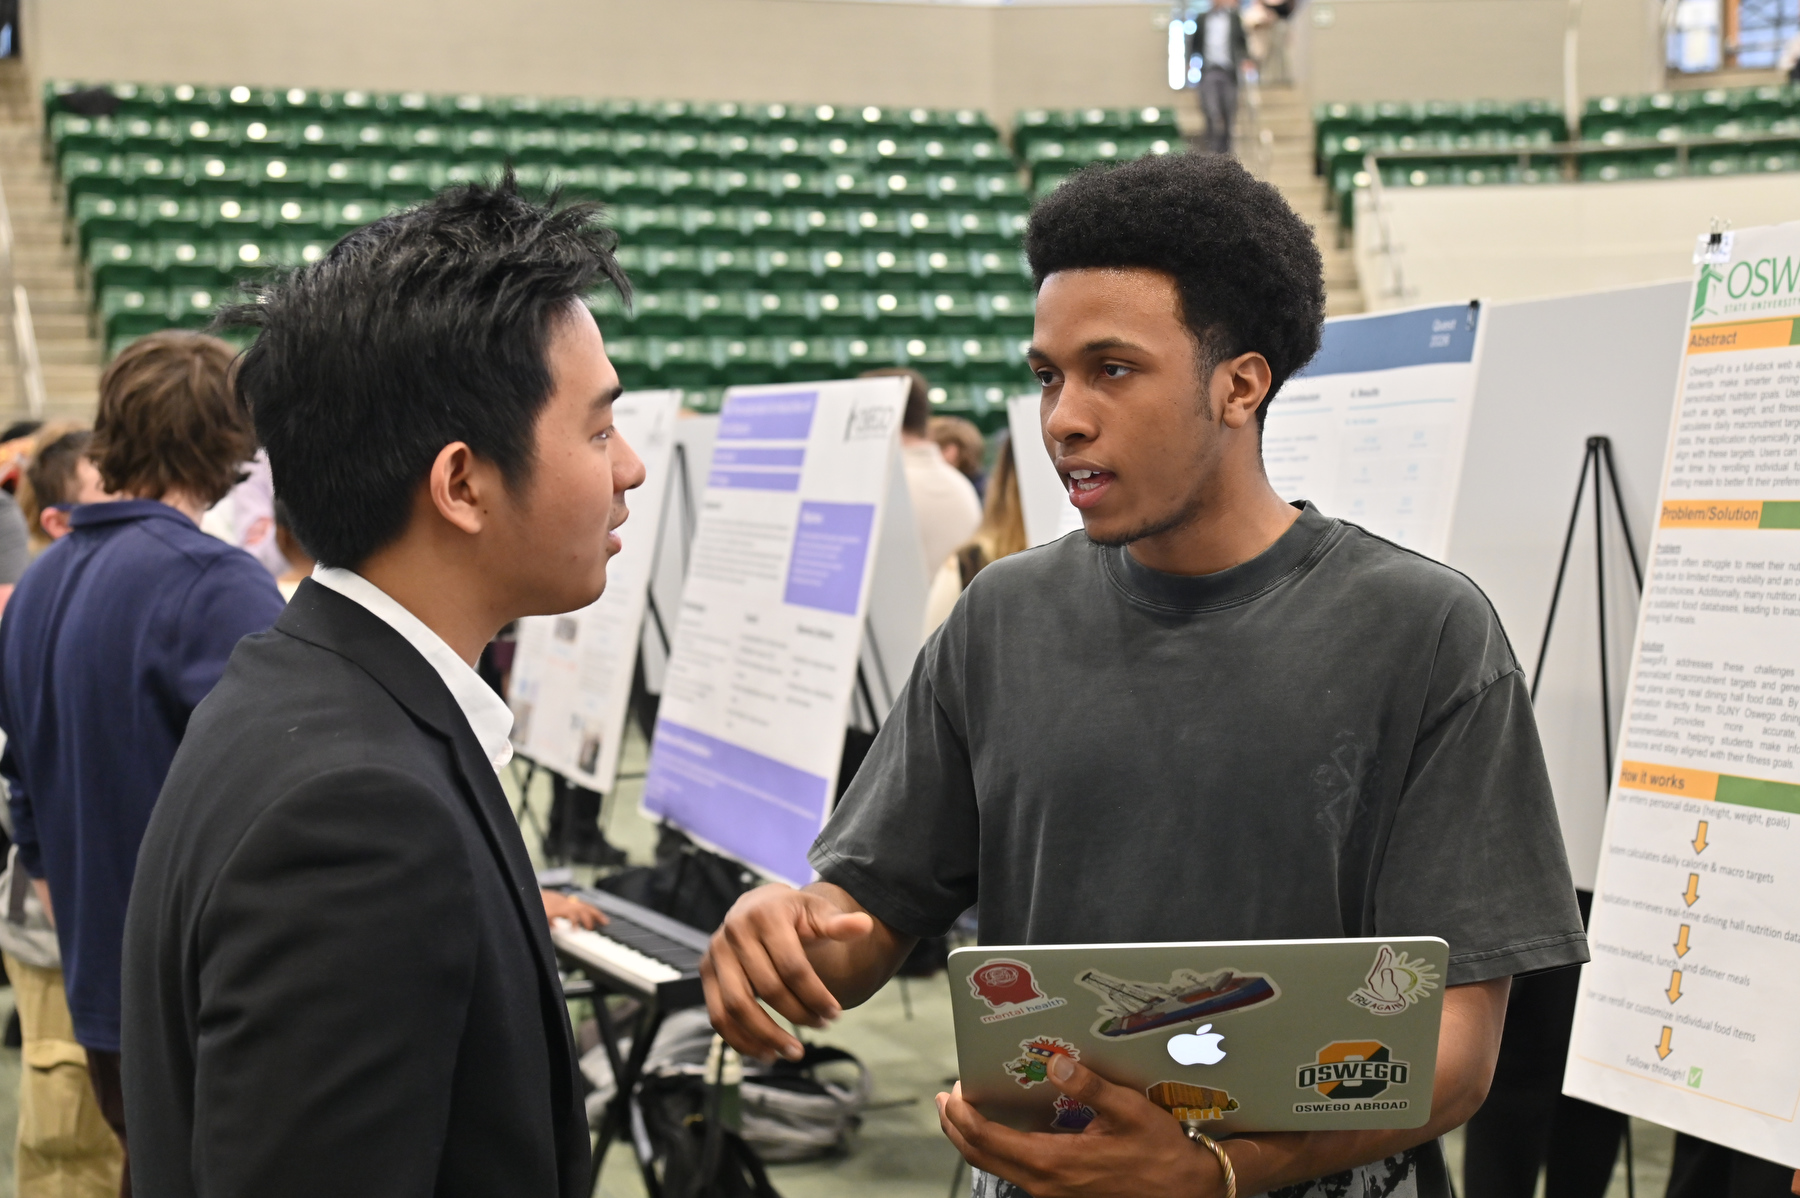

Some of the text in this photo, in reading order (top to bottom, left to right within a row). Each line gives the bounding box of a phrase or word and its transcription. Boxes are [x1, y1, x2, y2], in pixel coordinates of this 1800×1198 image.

[1724, 303, 1747, 314] STATE
[1689, 331, 1737, 347] Abstract
[1778, 360, 1793, 369] web
[1777, 374, 1800, 386] dining
[1729, 391, 1757, 402] nutrition
[1761, 404, 1775, 414] and
[1733, 419, 1782, 430] macronutrient
[1749, 432, 1791, 445] dynamically
[1760, 447, 1781, 457] Users
[1783, 448, 1797, 457] can
[1755, 461, 1789, 472] individual
[1662, 506, 1759, 521] Problem/Solution
[1702, 558, 1731, 571] struggle
[1735, 560, 1743, 569] to
[1745, 560, 1765, 570] meet
[1768, 560, 1785, 571] their
[1711, 574, 1734, 584] macro
[1736, 573, 1766, 587] visibility
[1767, 575, 1782, 586] and
[1783, 577, 1793, 586] an
[1743, 590, 1764, 602] many
[1766, 590, 1797, 601] nutrition
[1743, 604, 1770, 618] leading
[1773, 605, 1780, 616] to
[1675, 657, 1713, 670] addresses
[1723, 661, 1744, 673] these
[1753, 664, 1795, 679] challenges
[1675, 672, 1726, 685] macronutrient
[1730, 677, 1757, 690] targets
[1761, 681, 1777, 691] and
[1666, 687, 1686, 699] using
[1688, 687, 1702, 698] real
[1704, 689, 1727, 703] dining
[1730, 691, 1745, 702] hall
[1747, 693, 1764, 705] food
[1788, 697, 1800, 711] By
[1695, 702, 1712, 714] from
[1716, 704, 1741, 717] SUNY
[1744, 707, 1776, 722] Oswego
[1673, 715, 1705, 729] provides
[1723, 721, 1744, 732] more
[1762, 726, 1796, 739] accurate,
[1687, 731, 1715, 745] helping
[1721, 736, 1753, 749] students
[1760, 741, 1781, 752] make
[1664, 744, 1678, 756] stay
[1680, 746, 1709, 759] aligned
[1709, 750, 1725, 761] with
[1727, 751, 1745, 763] their
[1746, 754, 1771, 767] fitness
[1621, 769, 1685, 790] How it works
[1649, 798, 1681, 812] personal
[1683, 801, 1700, 814] data
[1702, 804, 1732, 820] (height,
[1734, 810, 1763, 825] weight,
[1765, 816, 1790, 830] goals)
[1661, 853, 1680, 868] daily
[1681, 856, 1708, 872] calorie
[1710, 861, 1717, 873] &
[1719, 866, 1744, 878] macro
[1746, 869, 1774, 884] targets
[1632, 900, 1663, 915] retrieves
[1665, 906, 1700, 922] real-time
[1702, 913, 1728, 930] dining
[1730, 918, 1745, 932] hall
[1746, 924, 1782, 940] nutrition
[1682, 962, 1698, 974] and
[1700, 965, 1725, 981] dinner
[1726, 972, 1750, 987] meals
[983, 998, 1065, 1022] mental health
[1350, 993, 1404, 1011] TRY AGAIN
[1626, 1000, 1633, 1010] or
[1634, 1001, 1674, 1021] customize
[1675, 1012, 1712, 1031] individual
[1714, 1021, 1731, 1036] food
[1732, 1027, 1756, 1043] items
[1299, 1062, 1408, 1088] OSWEGO
[1626, 1054, 1685, 1081] Follow through!
[1172, 1106, 1223, 1120] Hart
[1295, 1101, 1408, 1113] OSWEGO ABROAD
